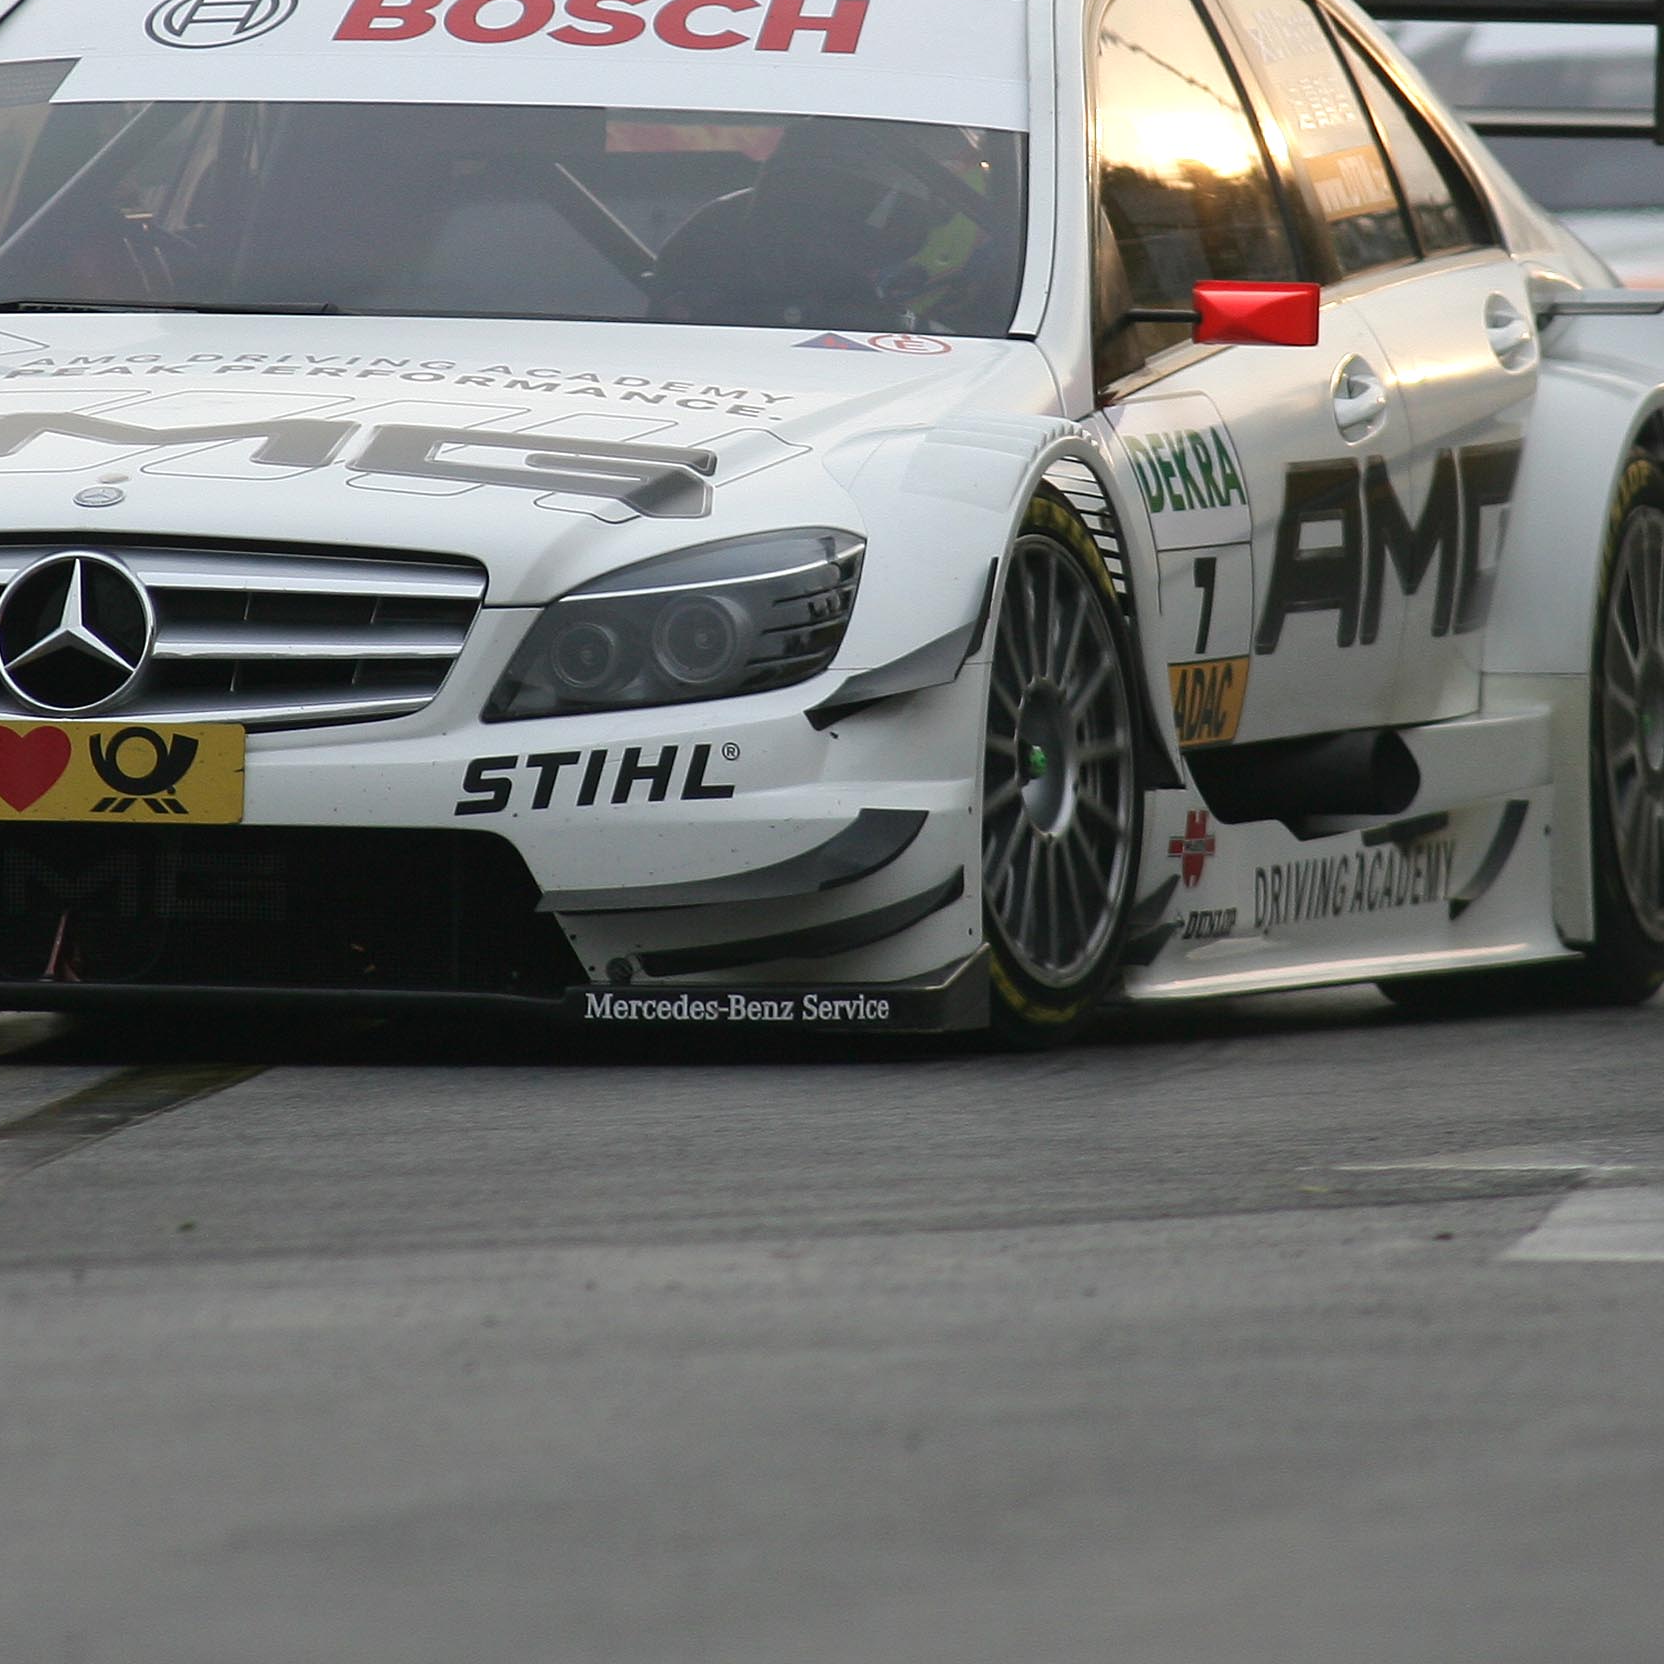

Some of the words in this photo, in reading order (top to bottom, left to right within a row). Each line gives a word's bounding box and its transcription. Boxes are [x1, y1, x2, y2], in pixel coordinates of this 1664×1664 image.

[3, 365, 185, 379] PEAK
[18, 352, 162, 367] AMG
[186, 352, 457, 371] DRIVING
[473, 363, 795, 406] ACADEMY
[1135, 426, 1247, 514] DEKRA
[1174, 663, 1232, 741] ADAC
[1254, 854, 1351, 929] DRIVING
[1350, 838, 1456, 914] ACADEMY
[585, 993, 794, 1021] Mercedes-Benz
[802, 994, 890, 1021] Service
